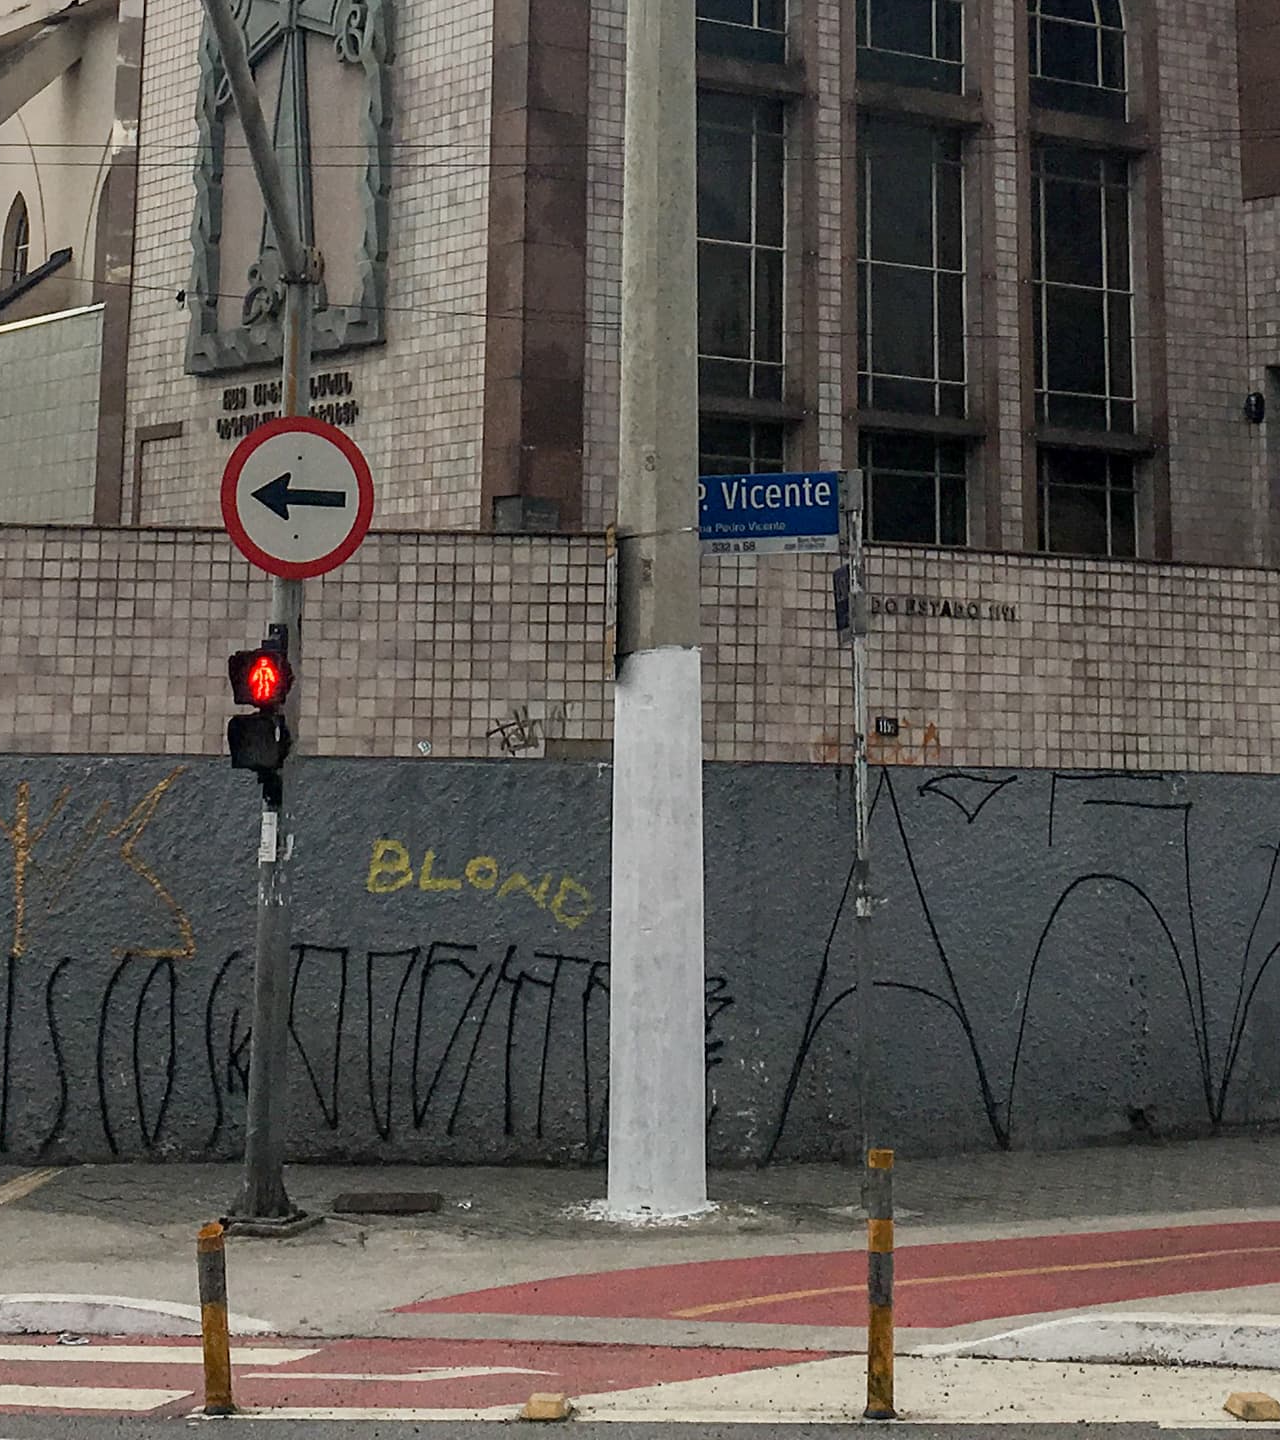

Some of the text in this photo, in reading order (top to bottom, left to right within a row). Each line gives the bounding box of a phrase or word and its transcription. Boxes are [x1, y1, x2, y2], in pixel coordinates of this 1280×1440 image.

[721, 478, 831, 510] Vicente
[715, 522, 746, 533] Pedro
[748, 521, 786, 531] Vicente
